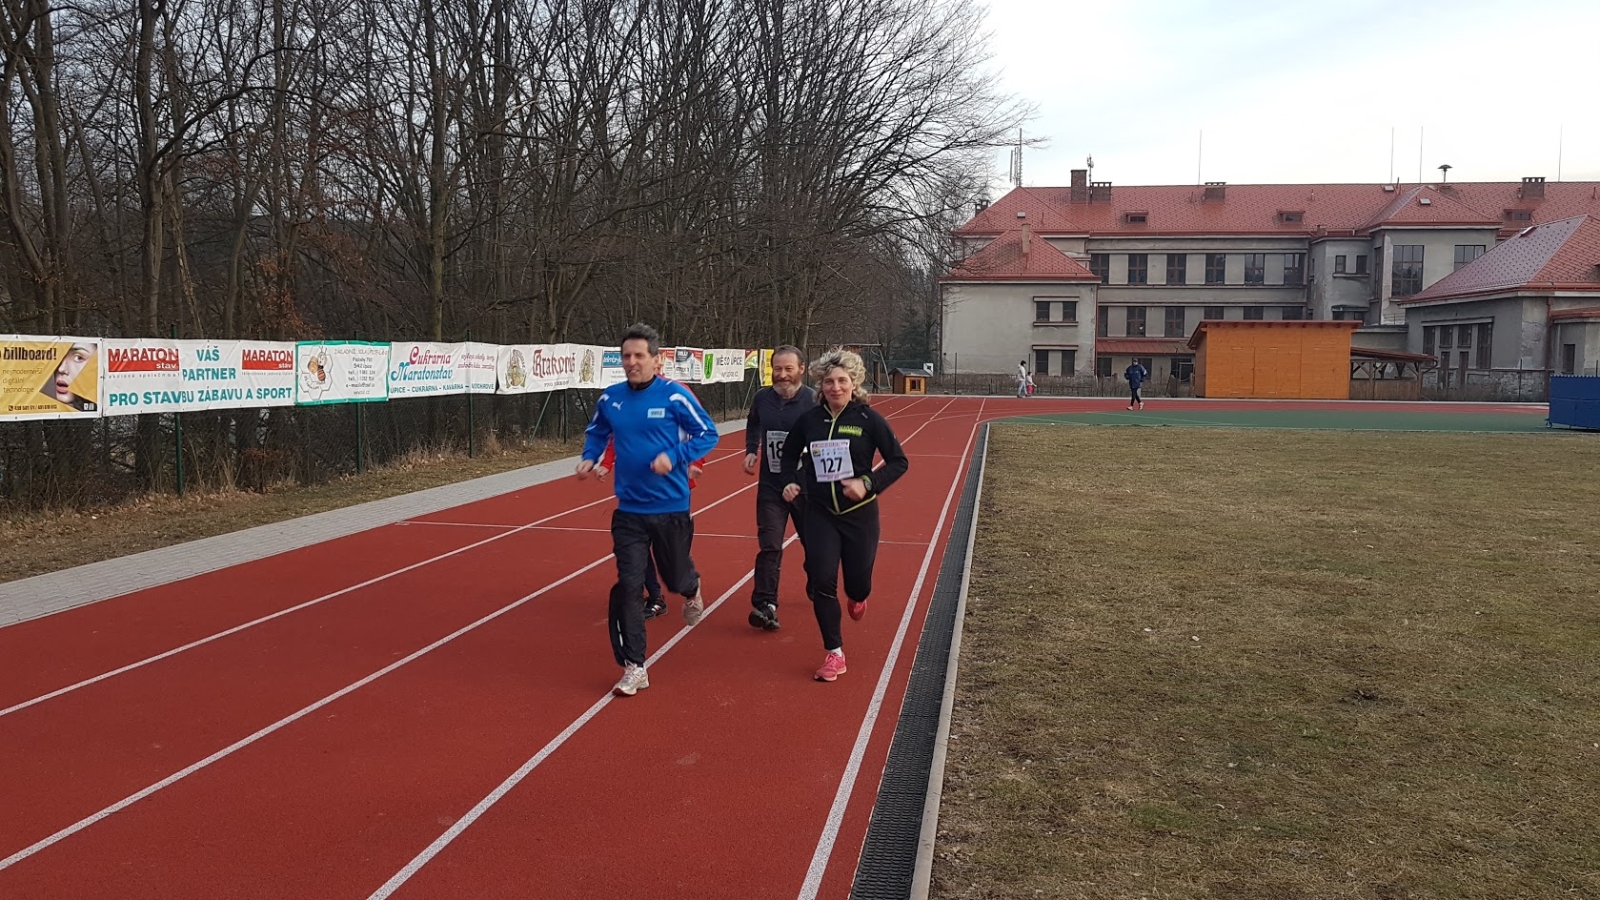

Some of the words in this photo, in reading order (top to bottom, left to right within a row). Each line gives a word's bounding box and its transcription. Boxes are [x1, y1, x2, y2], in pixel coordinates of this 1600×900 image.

[3, 346, 57, 361] billboard!
[108, 348, 179, 362] MARATON
[196, 346, 220, 361] VÁŠ
[242, 349, 293, 361] MARATON
[409, 346, 451, 365] Cukrárna
[155, 362, 178, 370] stav
[390, 362, 453, 381] Maratonstav
[182, 367, 236, 381] PARTNER
[109, 392, 139, 407] PRO
[143, 390, 194, 404] STAVBU
[198, 386, 243, 402] ZÁBAVU
[245, 388, 253, 400] A
[256, 387, 292, 400] SPORT
[820, 457, 843, 474] 127
